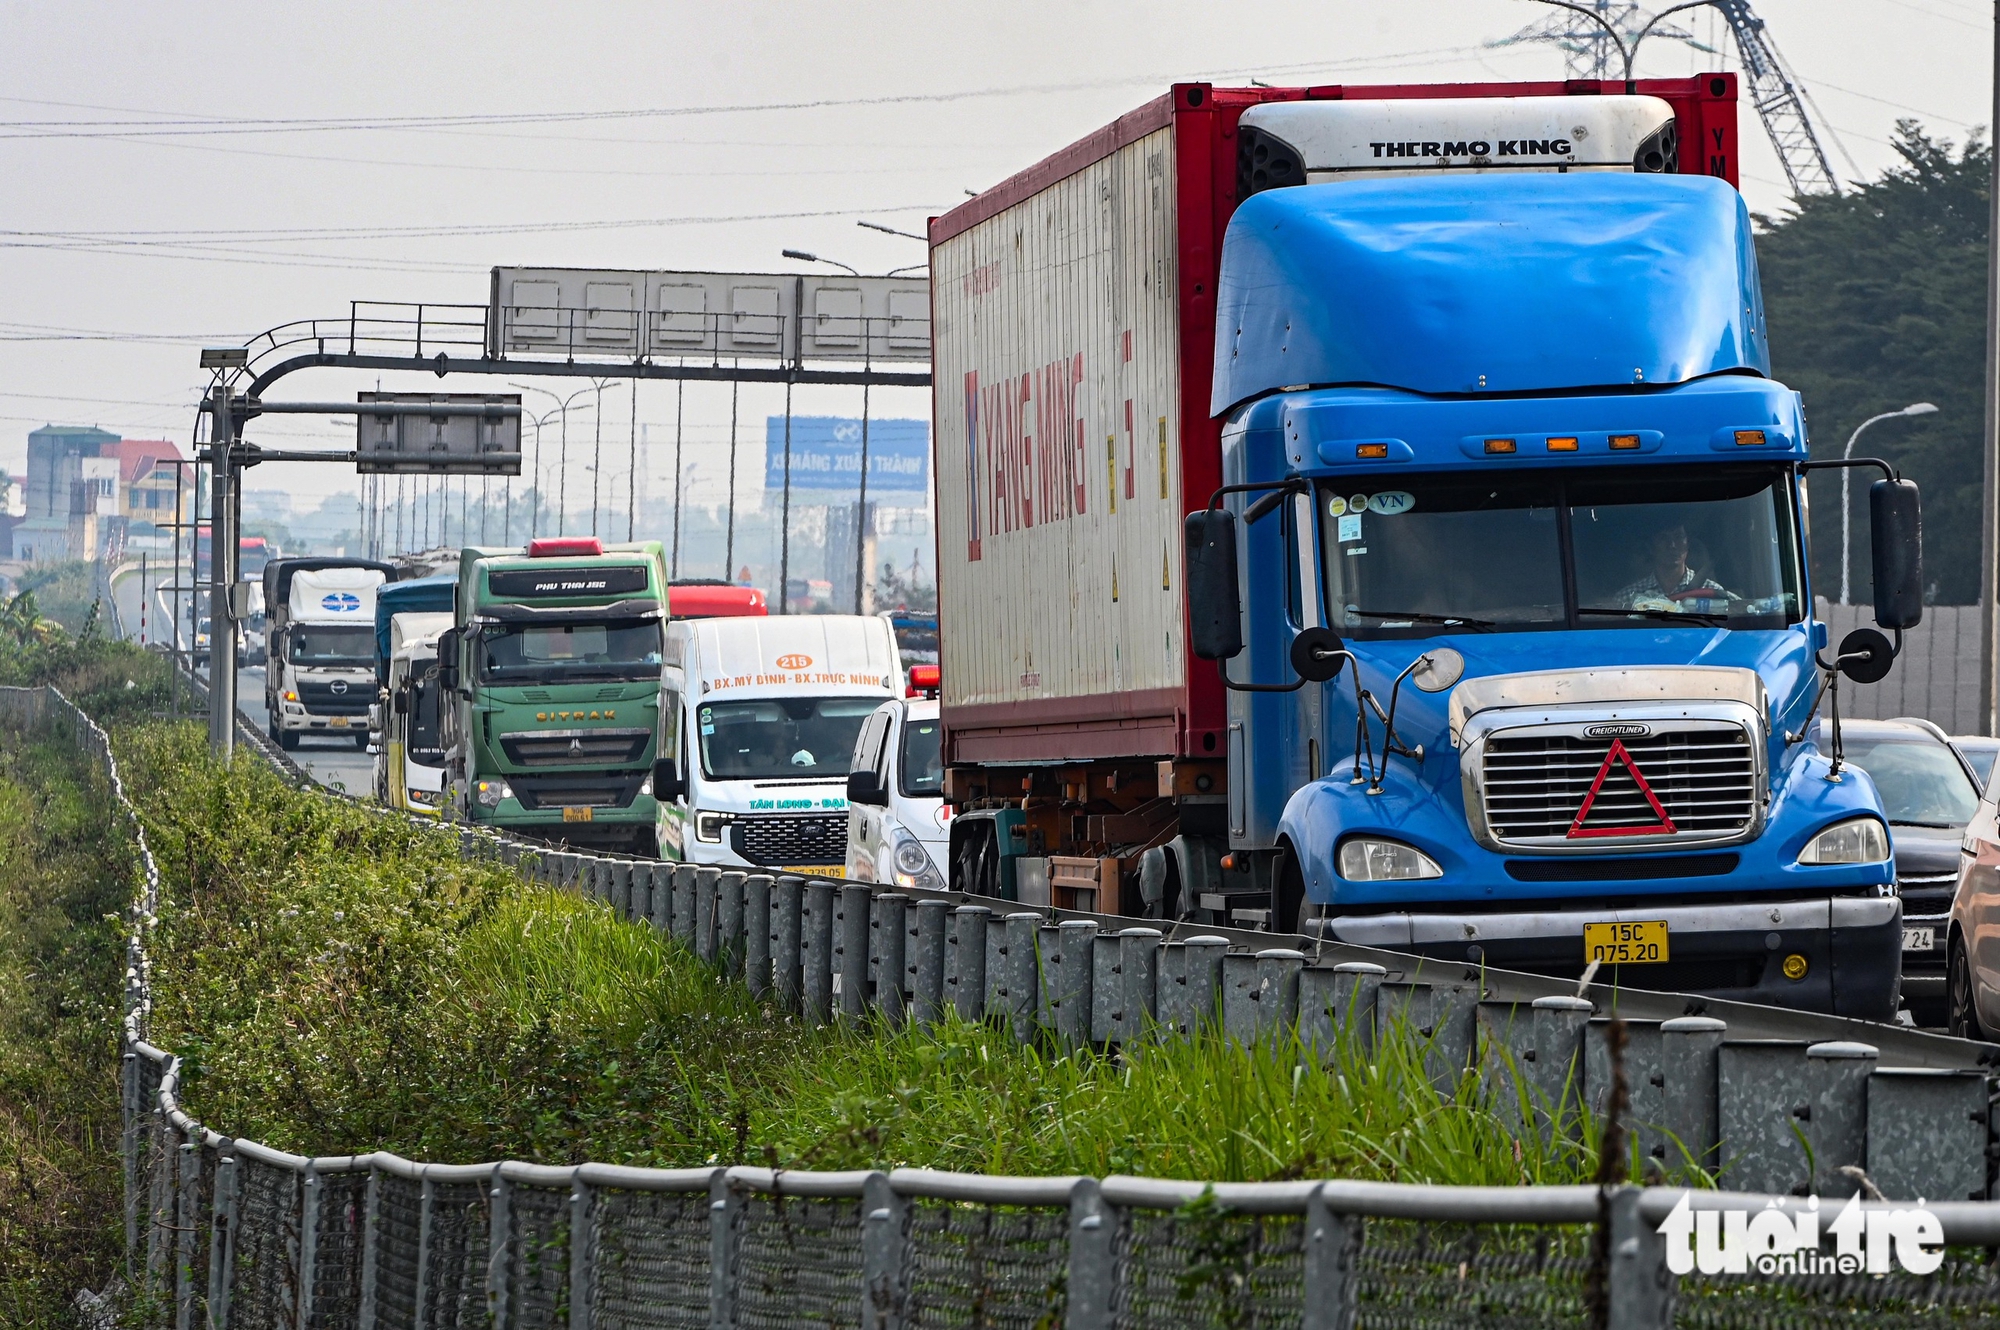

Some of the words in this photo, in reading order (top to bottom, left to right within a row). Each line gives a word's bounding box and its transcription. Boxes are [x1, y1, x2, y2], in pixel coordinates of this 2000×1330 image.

[1369, 140, 1491, 158] THERMO
[1497, 138, 1572, 156] KING
[983, 371, 1034, 537] YANG
[1036, 350, 1086, 527] MING
[1376, 494, 1405, 509] VN
[535, 582, 558, 591] PHU
[560, 581, 585, 590] THAI
[585, 581, 607, 589] JSC
[781, 656, 808, 668] 215
[536, 710, 616, 722] SITRAK
[1591, 726, 1644, 735] FREIGHTLINER
[749, 799, 775, 810] TÂN
[1610, 924, 1643, 942] 15C
[1593, 943, 1659, 962] 075.20
